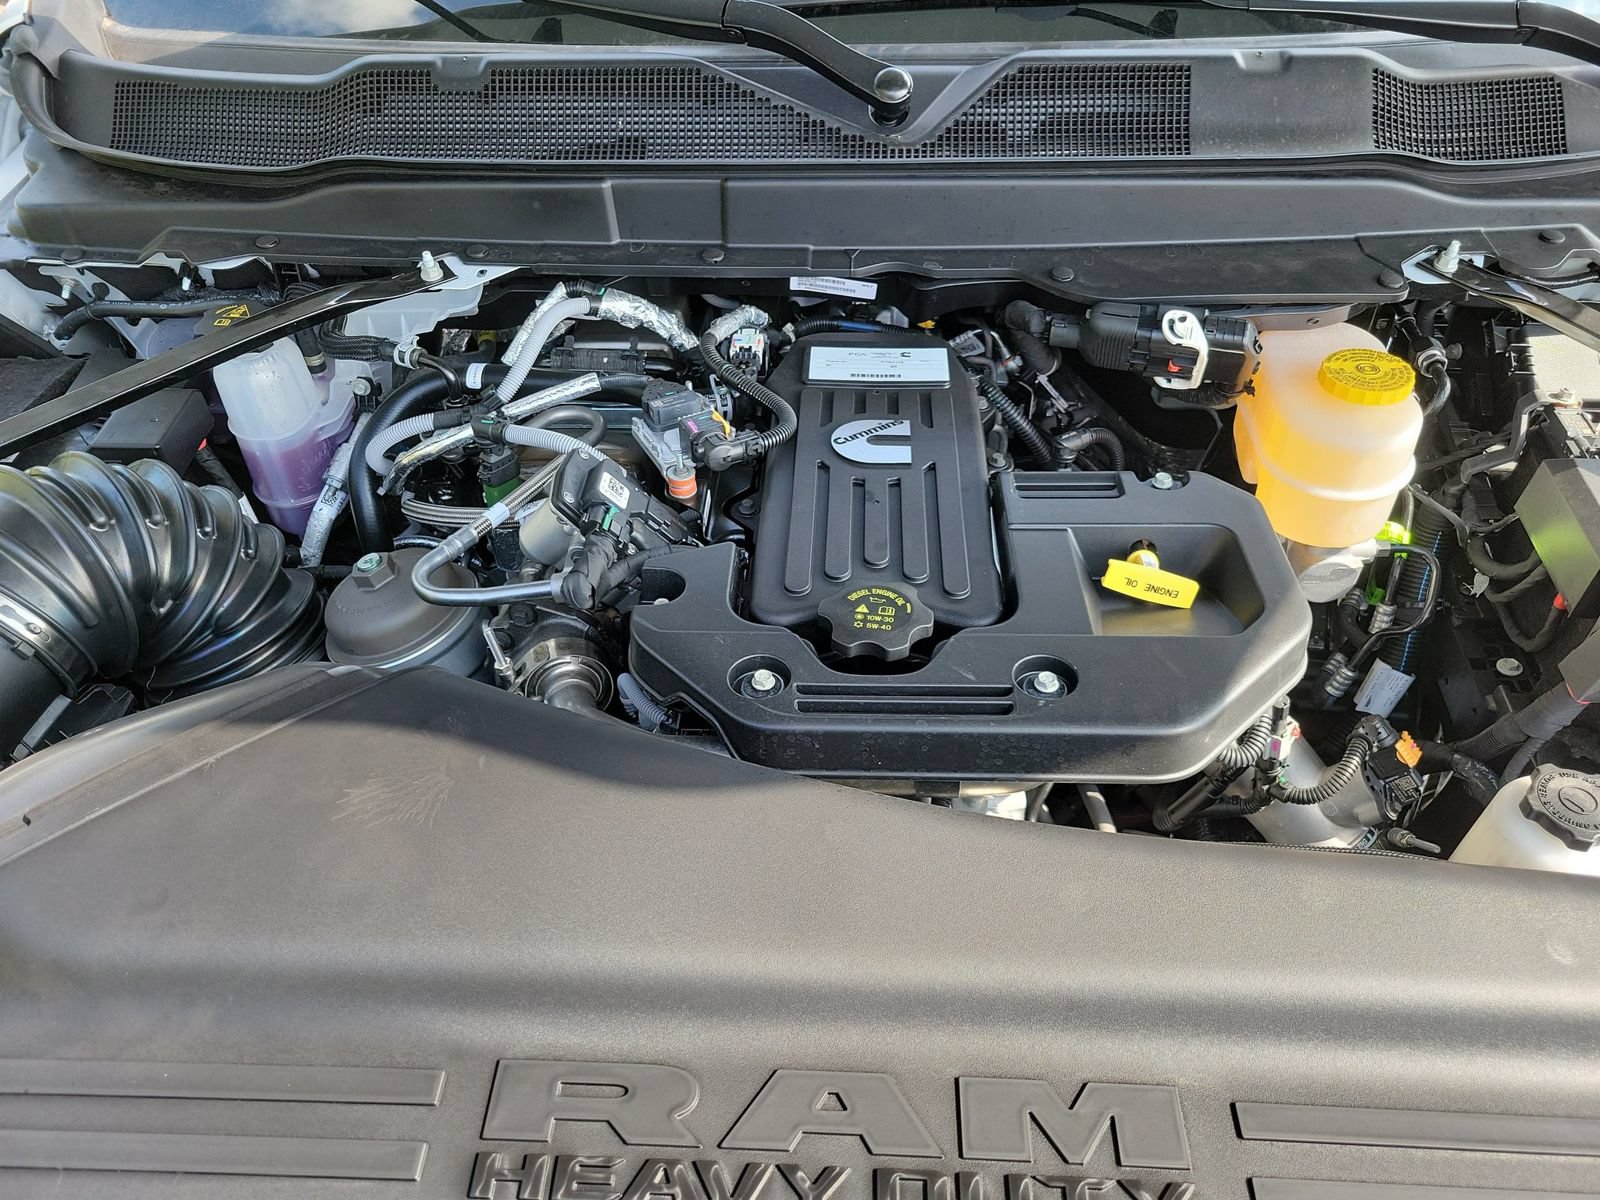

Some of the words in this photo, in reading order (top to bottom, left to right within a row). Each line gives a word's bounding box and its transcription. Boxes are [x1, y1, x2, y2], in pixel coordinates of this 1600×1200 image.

[833, 419, 904, 445] Cummins
[1125, 577, 1138, 588] OIL
[1144, 583, 1179, 599] ENGINE
[847, 589, 871, 602] DIESEL
[872, 588, 898, 599] ENGINE
[480, 1059, 1192, 1169] RAM
[467, 1152, 850, 1200] HEAVY
